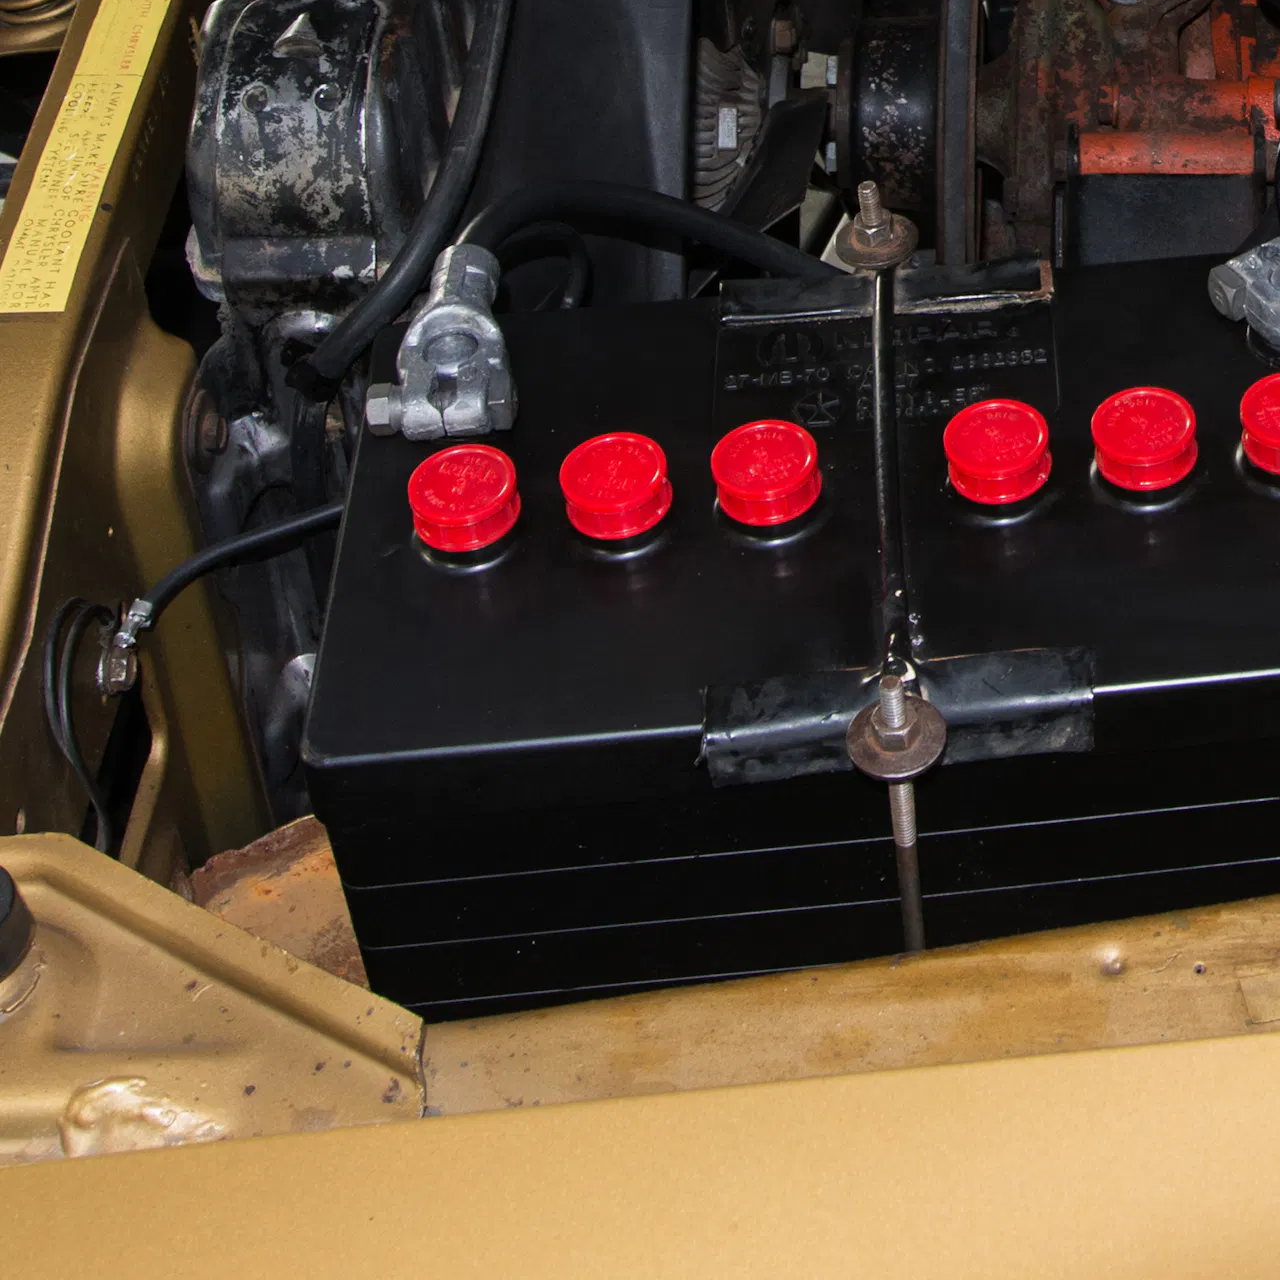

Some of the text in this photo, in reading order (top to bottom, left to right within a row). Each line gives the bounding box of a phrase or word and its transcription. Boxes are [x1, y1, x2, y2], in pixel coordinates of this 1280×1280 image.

[120, 24, 143, 70] CHRYSLER
[100, 83, 123, 127] ALWAYS
[84, 133, 107, 166] MAKE
[61, 185, 73, 200] OF
[72, 172, 90, 202] SURE
[78, 163, 106, 222] WARNING
[20, 218, 48, 272] MANUAL
[38, 209, 65, 266] CHRYSLER
[50, 209, 79, 273] COOLANT
[8, 283, 27, 308] FOR
[38, 280, 56, 308] HAS
